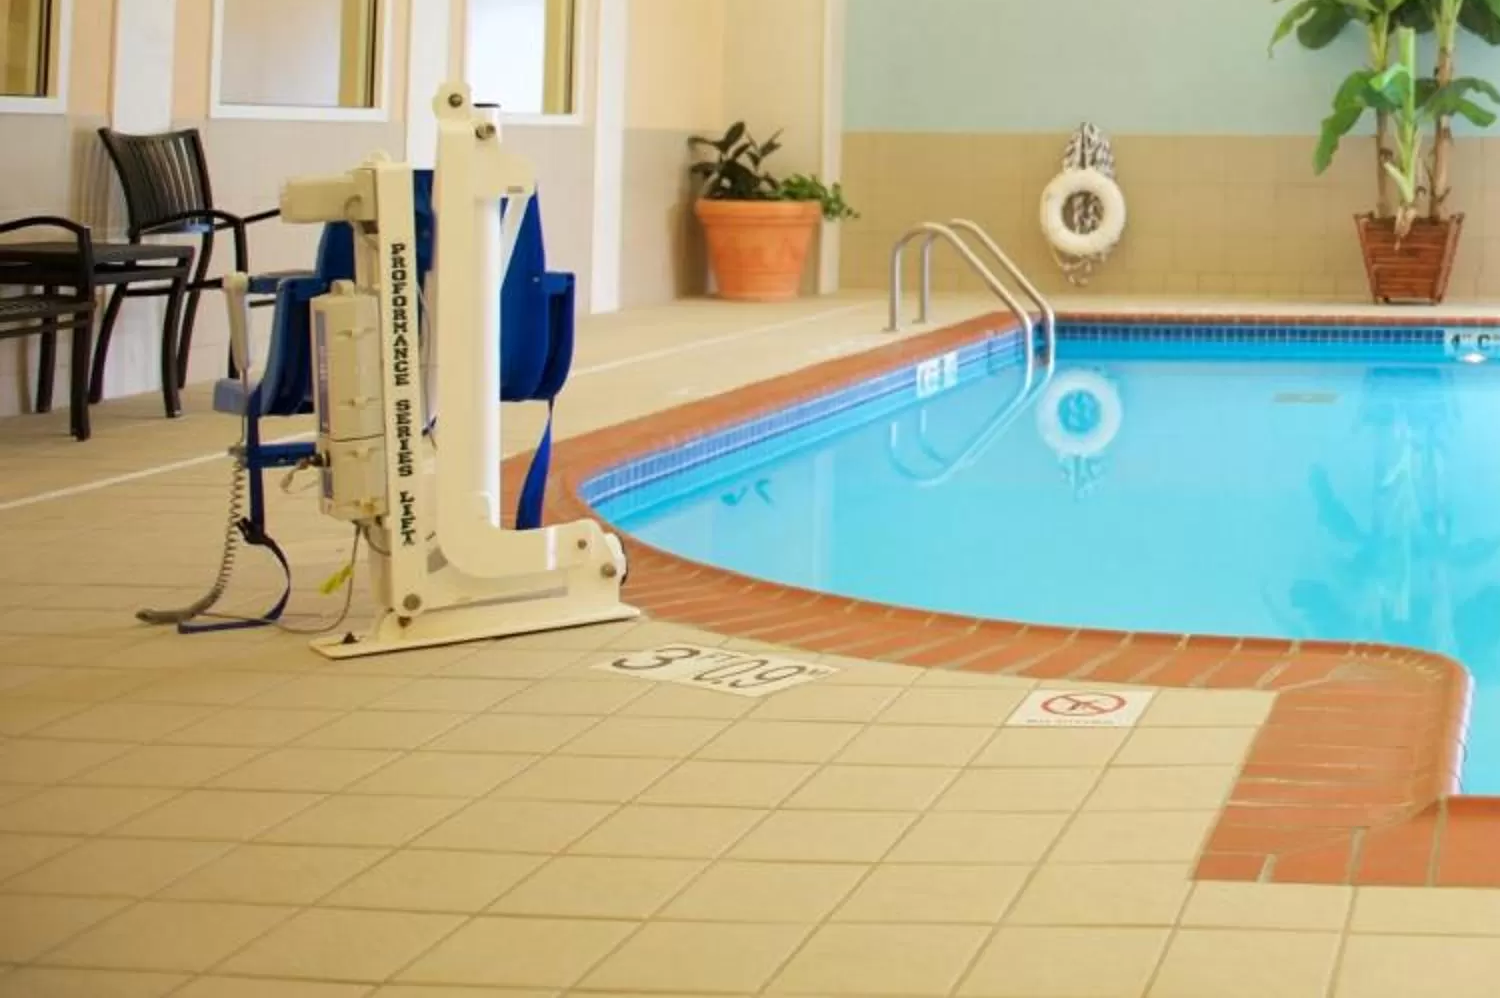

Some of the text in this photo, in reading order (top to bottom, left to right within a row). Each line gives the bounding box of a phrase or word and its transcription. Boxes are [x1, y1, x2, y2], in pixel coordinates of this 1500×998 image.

[390, 242, 416, 546] PROFORMANCE SERIES LIFT
